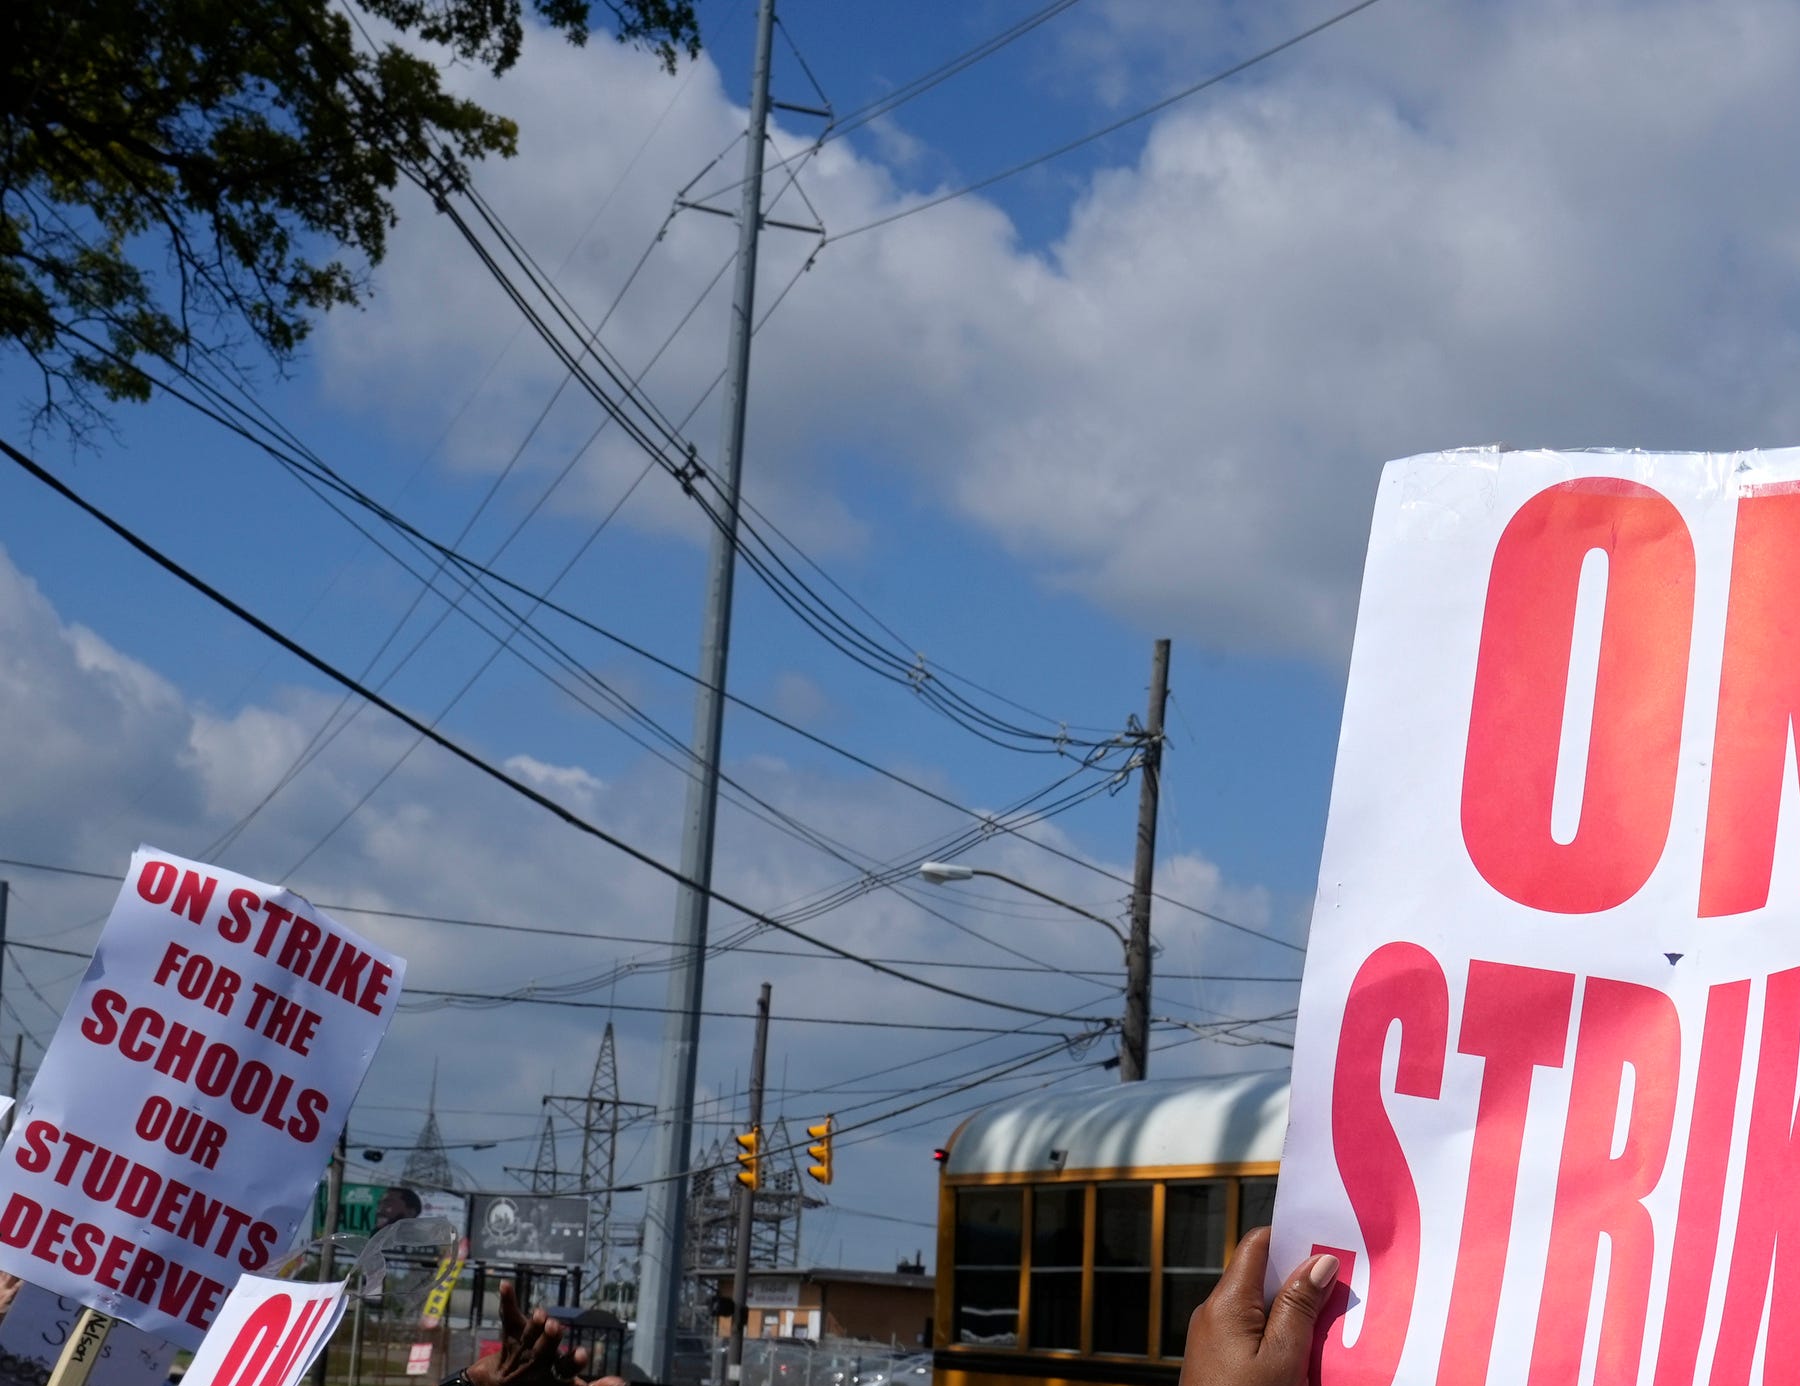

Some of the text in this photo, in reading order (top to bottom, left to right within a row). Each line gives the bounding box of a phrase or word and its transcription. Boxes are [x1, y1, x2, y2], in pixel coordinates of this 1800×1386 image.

[137, 861, 393, 1016] ON STRIKE
[153, 942, 322, 1057] FOR THE
[81, 989, 329, 1143] SCHOOLS
[136, 1095, 228, 1170] OUR
[0, 1192, 233, 1332] DESERVE
[15, 1120, 278, 1271] STUDENTS
[72, 1314, 108, 1363] Nelson
